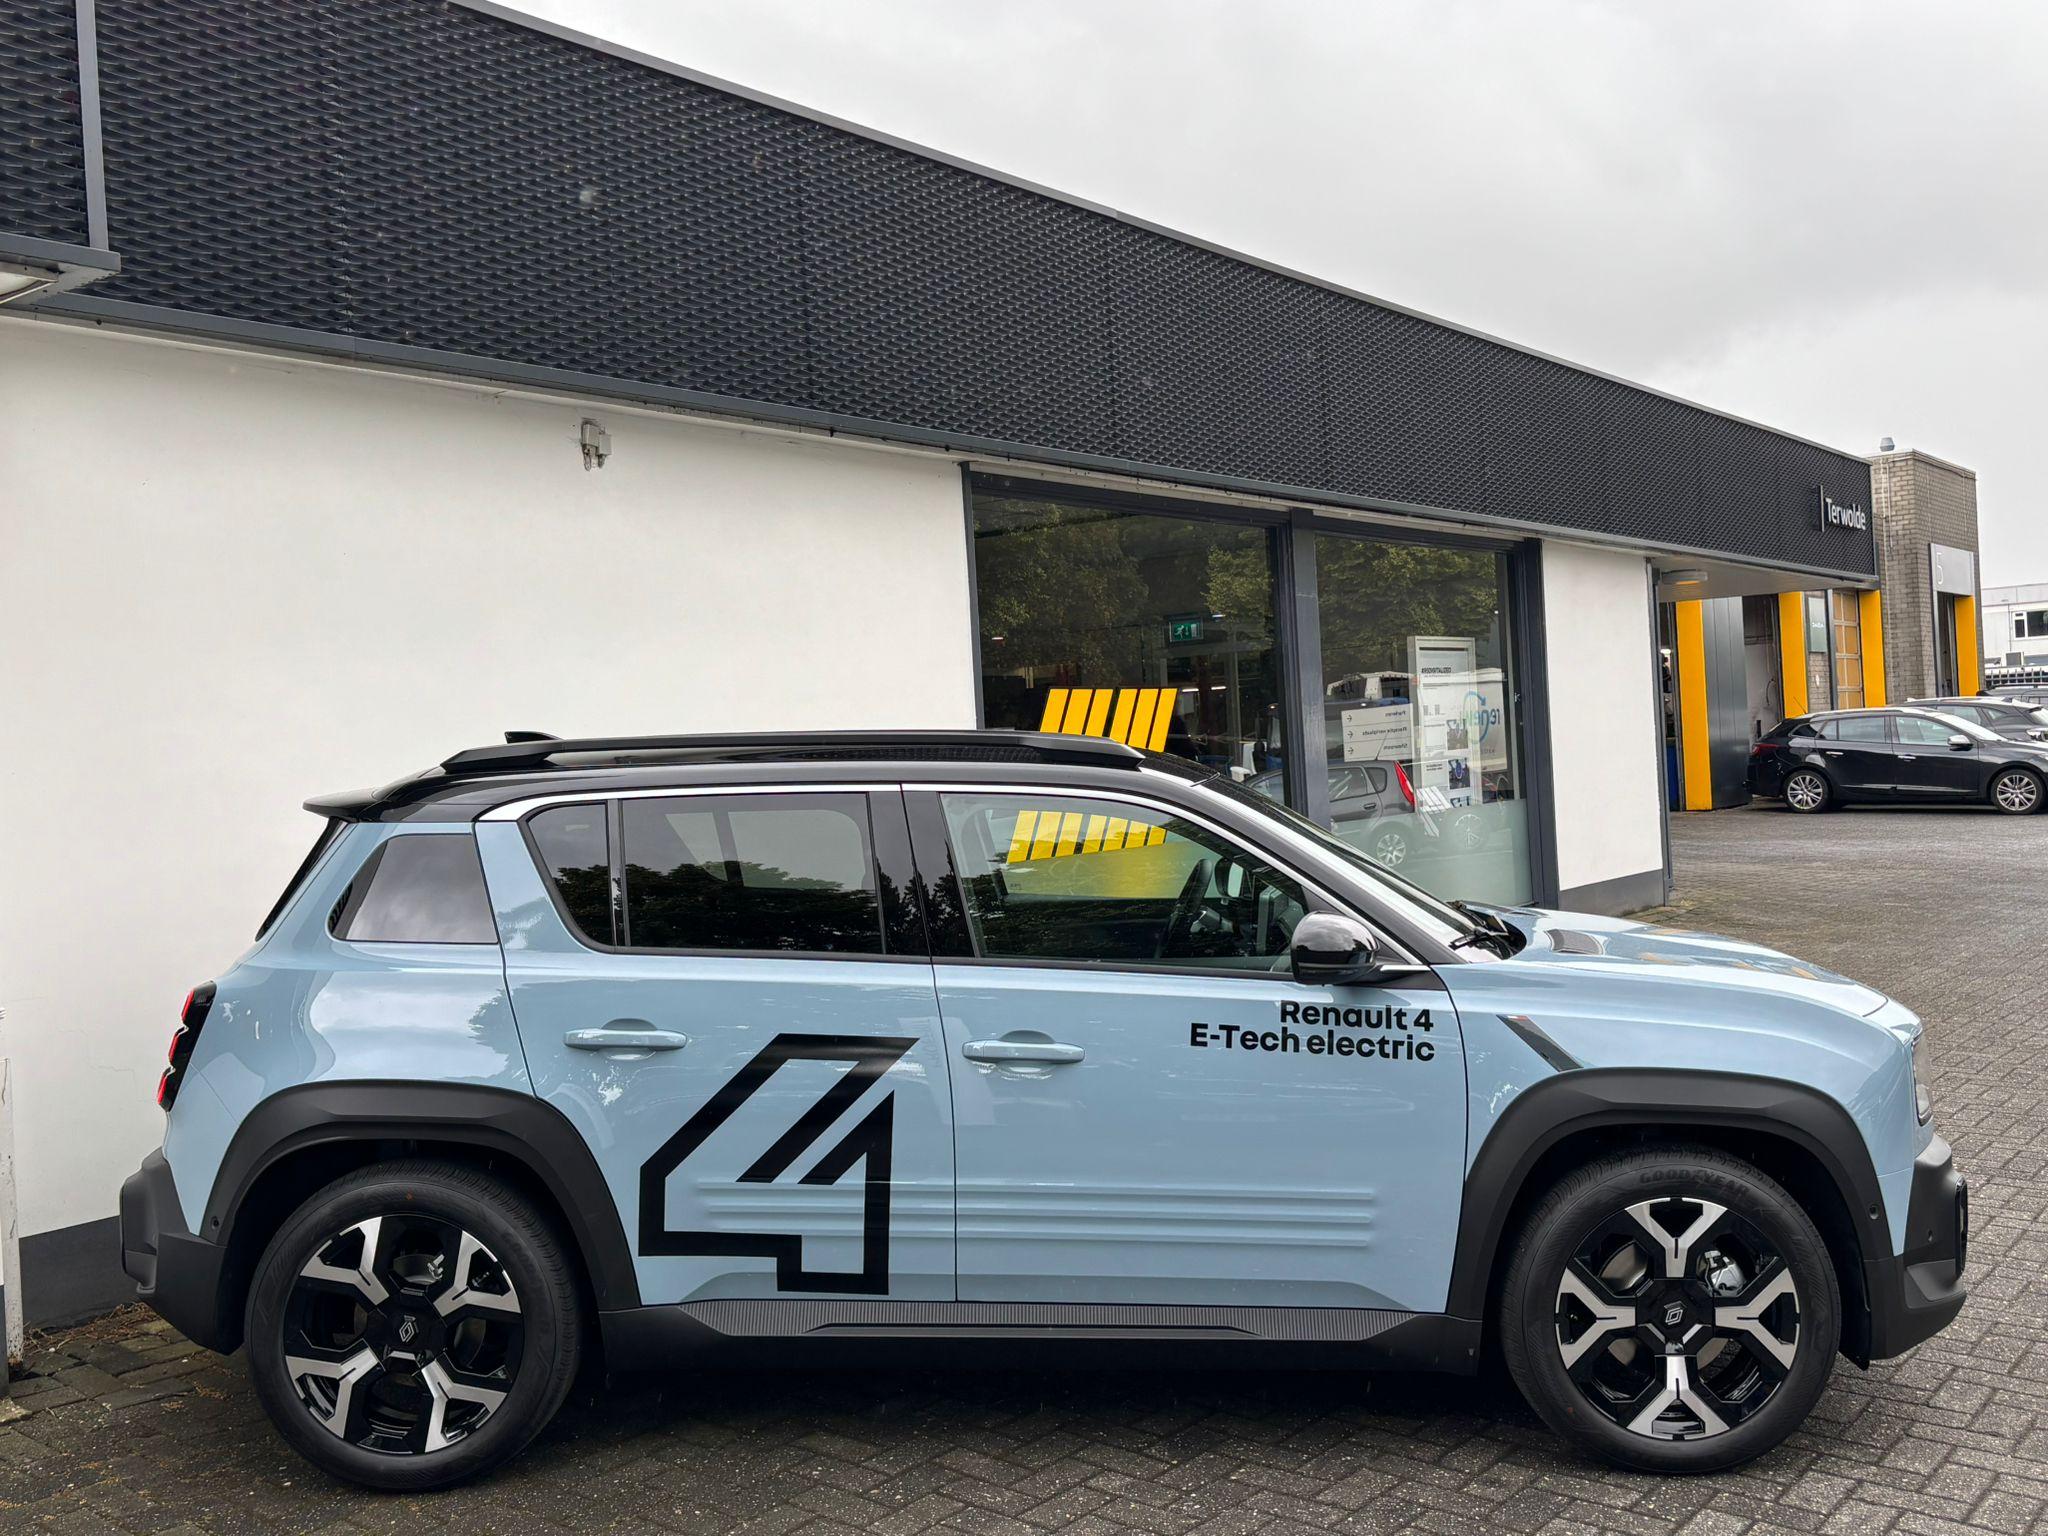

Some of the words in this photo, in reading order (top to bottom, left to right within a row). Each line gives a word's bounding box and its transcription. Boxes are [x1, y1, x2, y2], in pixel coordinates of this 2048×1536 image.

[1825, 498, 1866, 530] Terwolde
[1936, 552, 1944, 585] 5
[1280, 1000, 1408, 1030] Renault
[1413, 1009, 1434, 1032] 4
[1190, 1022, 1300, 1053] E-Tech
[1306, 1029, 1435, 1062] electric
